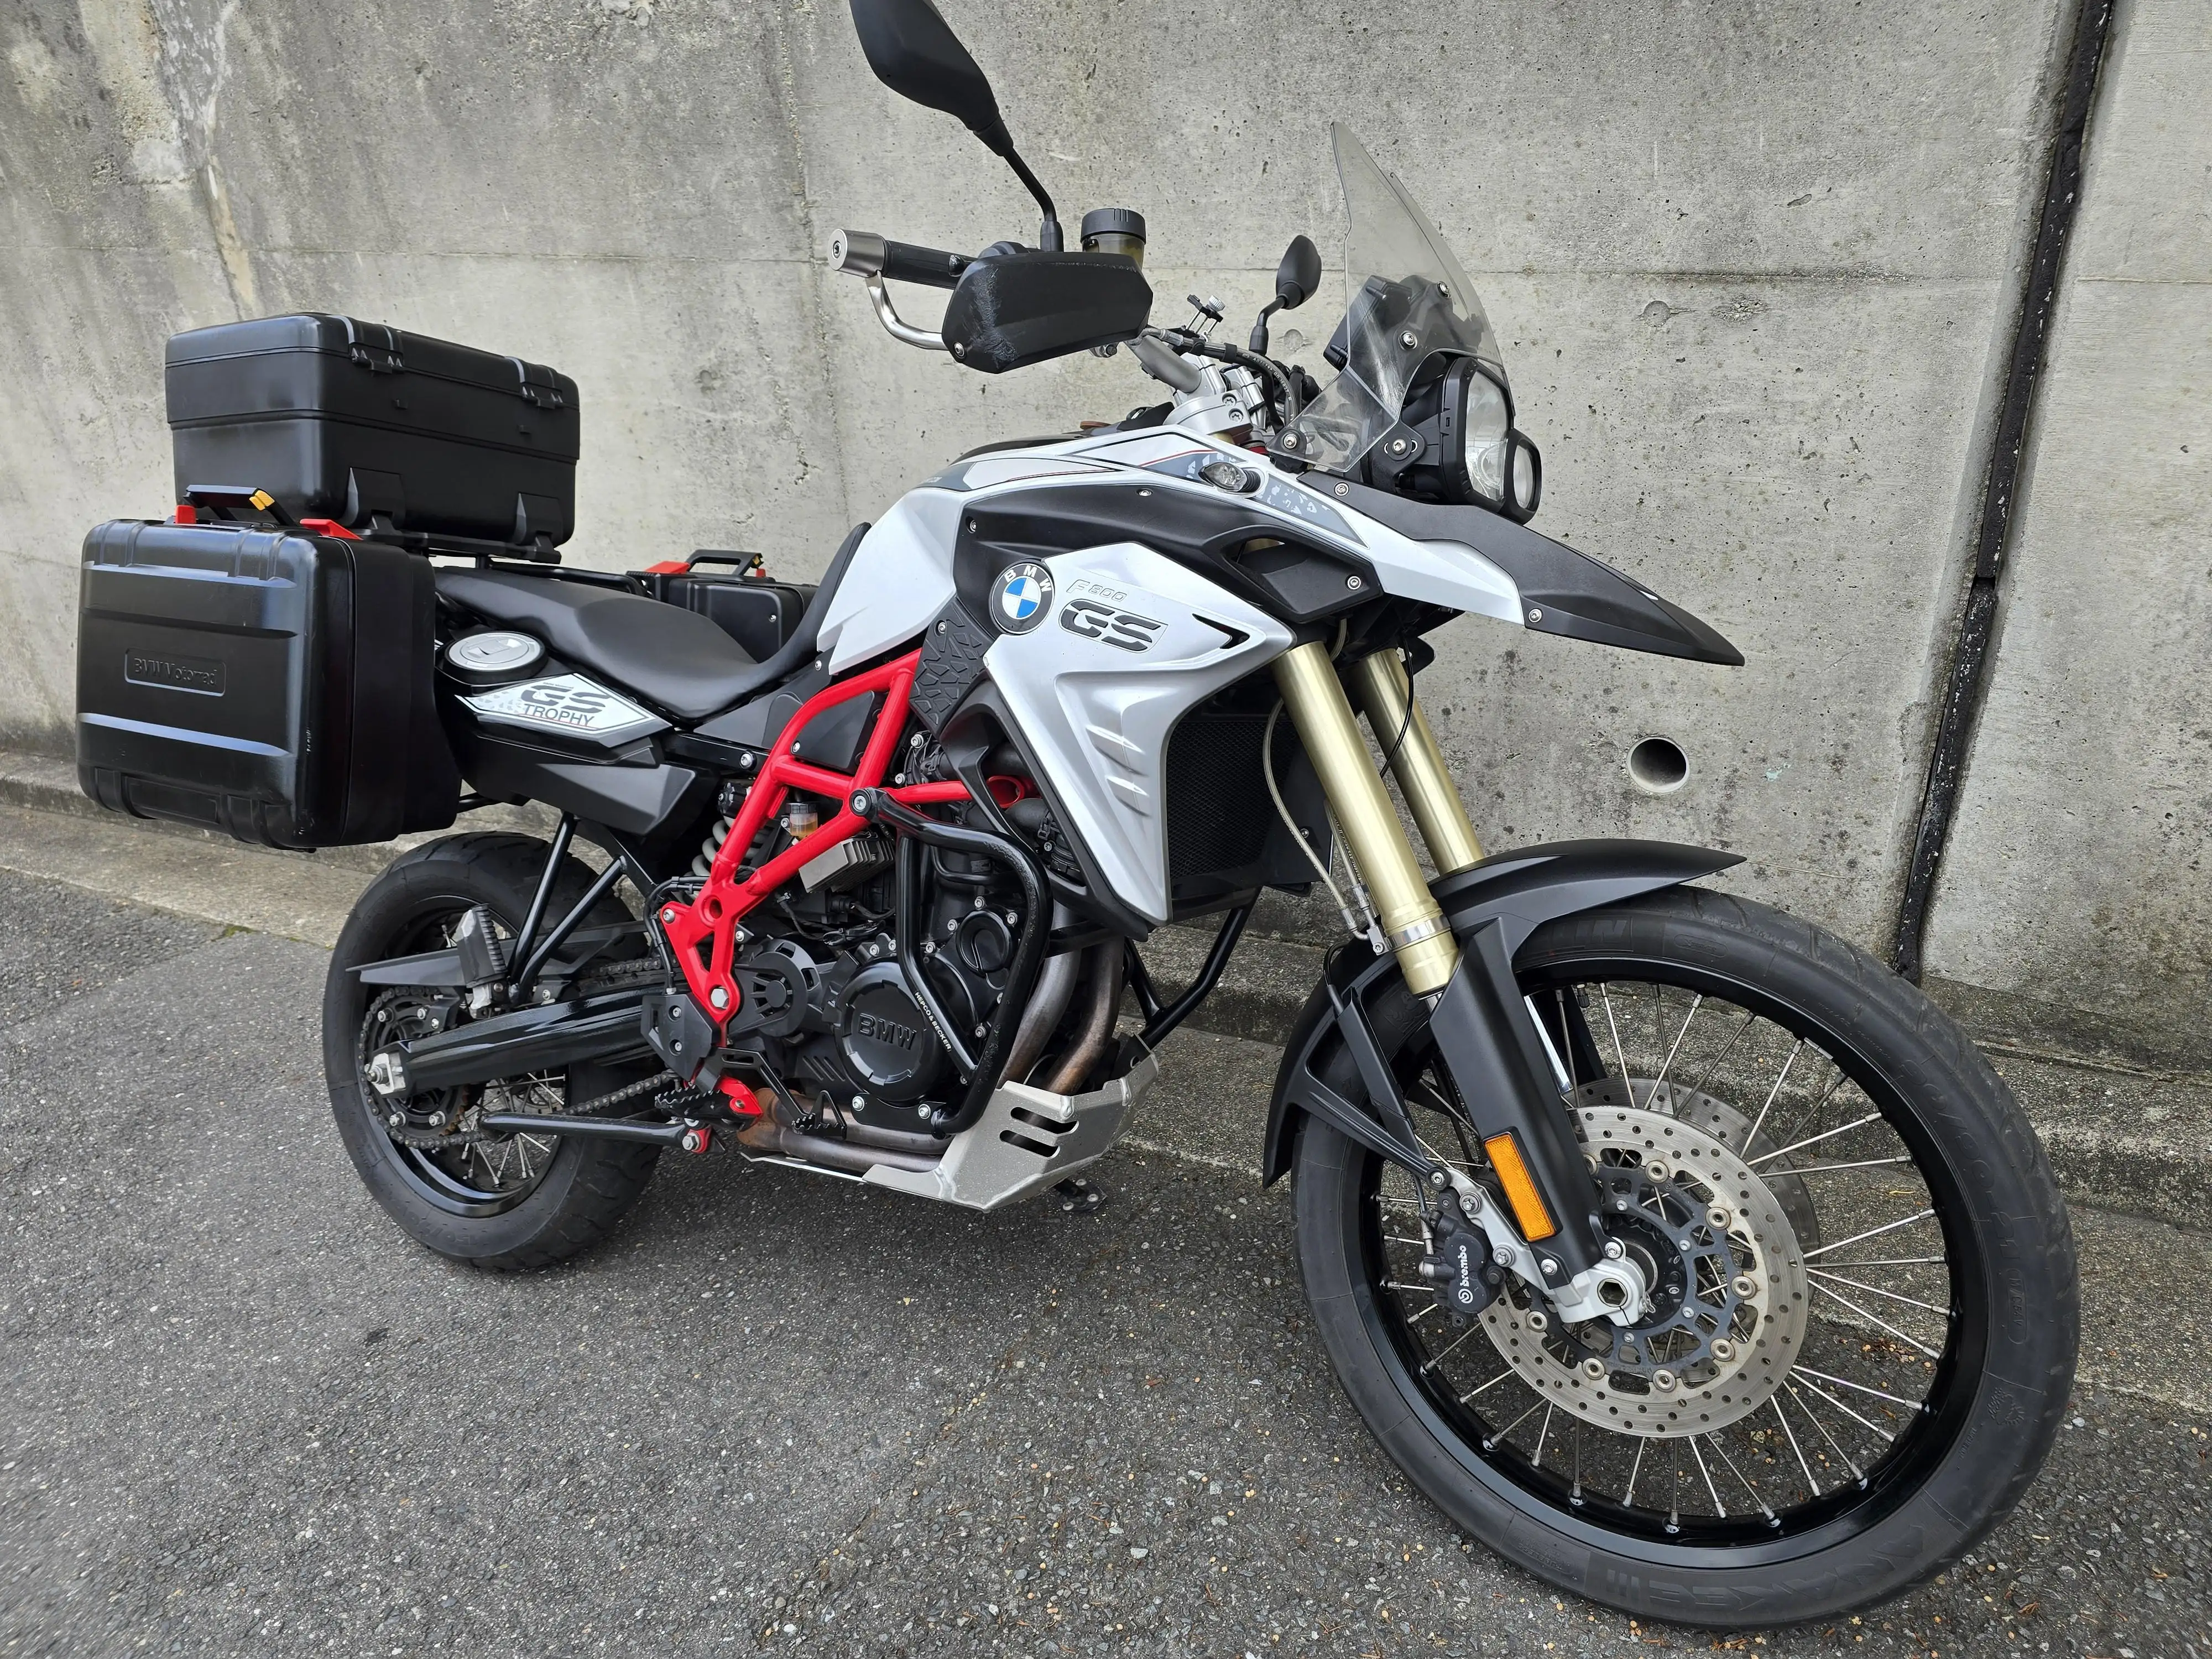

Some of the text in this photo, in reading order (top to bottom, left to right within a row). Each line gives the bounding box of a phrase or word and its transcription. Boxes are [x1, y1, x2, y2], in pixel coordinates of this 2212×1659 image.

[1004, 565, 1052, 592] BMW
[1066, 580, 1127, 602] F 800
[1061, 601, 1161, 651] GS
[134, 658, 218, 686] BMW Motorrad
[520, 685, 611, 713] GS
[524, 703, 595, 727] TROPHY
[858, 1013, 917, 1050] BMW
[1458, 1245, 1469, 1287] brembo
